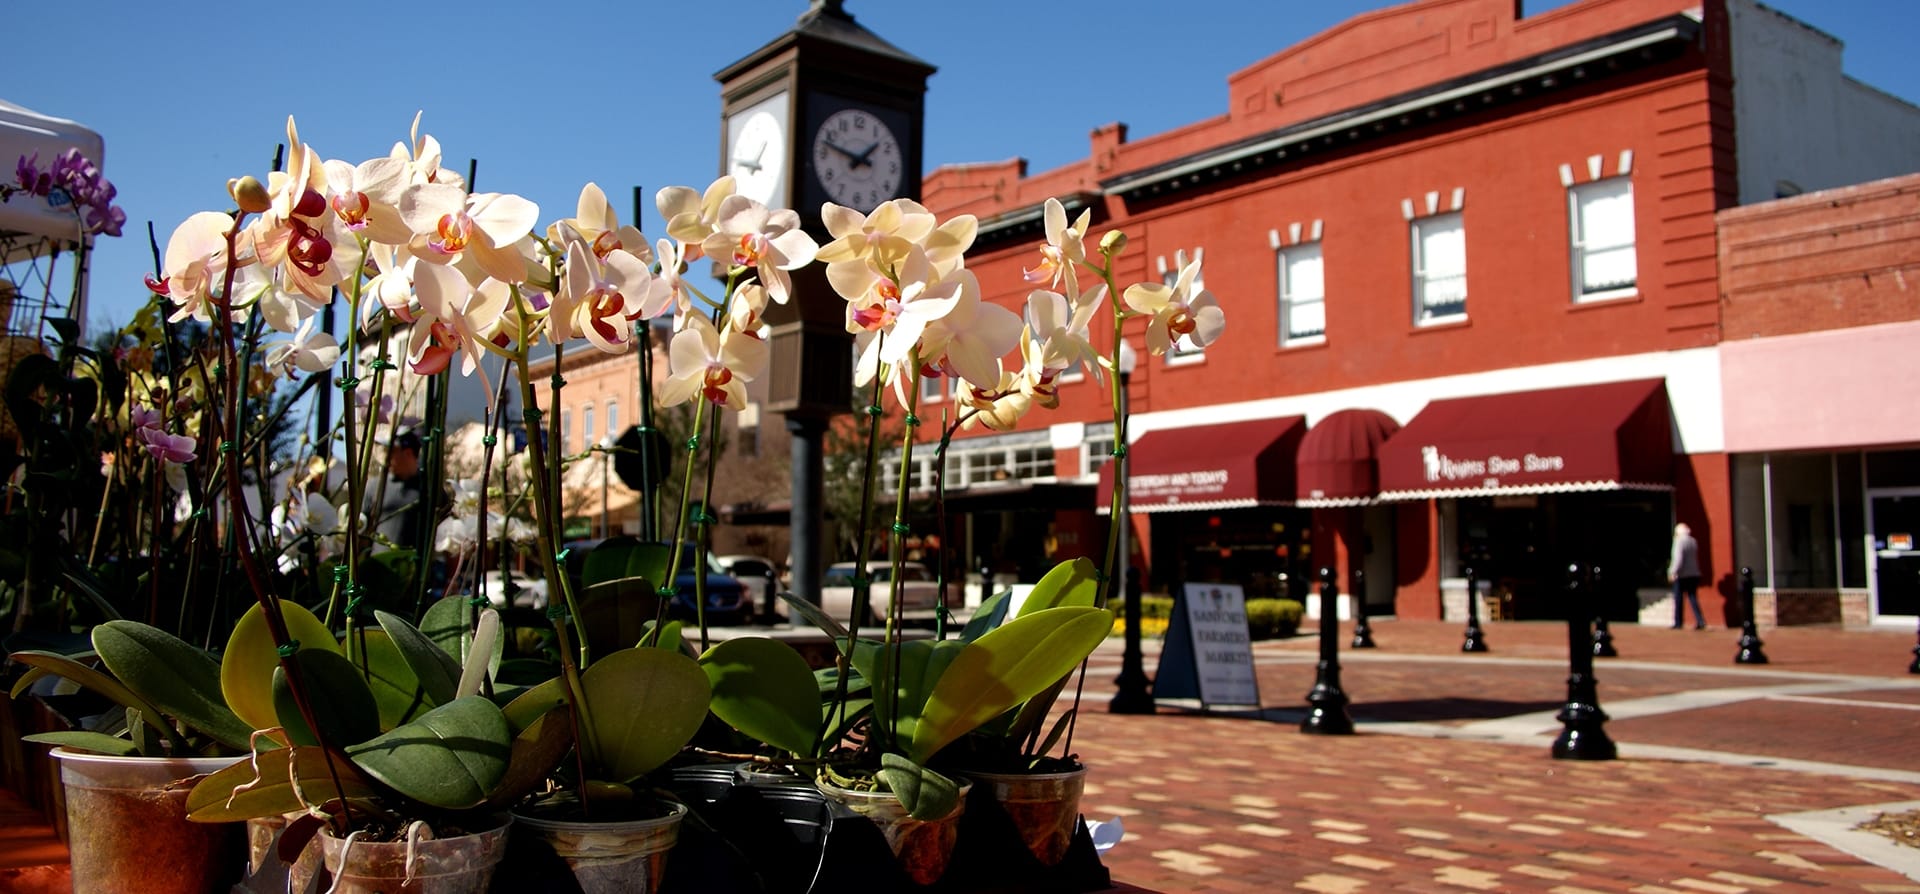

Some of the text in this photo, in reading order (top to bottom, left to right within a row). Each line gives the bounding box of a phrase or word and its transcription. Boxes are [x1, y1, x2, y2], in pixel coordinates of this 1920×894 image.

[839, 119, 848, 133] 11
[855, 115, 865, 130] 12
[884, 142, 891, 154] 2
[889, 161, 896, 174] 3
[825, 168, 833, 181] 8
[839, 184, 846, 197] 7
[883, 181, 890, 193] 4
[852, 192, 861, 205] 6
[870, 190, 878, 203] 5
[1488, 456, 1520, 475] Shoe
[1524, 453, 1563, 472] Store
[1128, 474, 1168, 488] ESTERDAY
[1171, 473, 1190, 486] AND
[1193, 611, 1246, 624] SANFORD
[1198, 631, 1247, 643] FARMERS
[1206, 651, 1248, 664] MARKET
